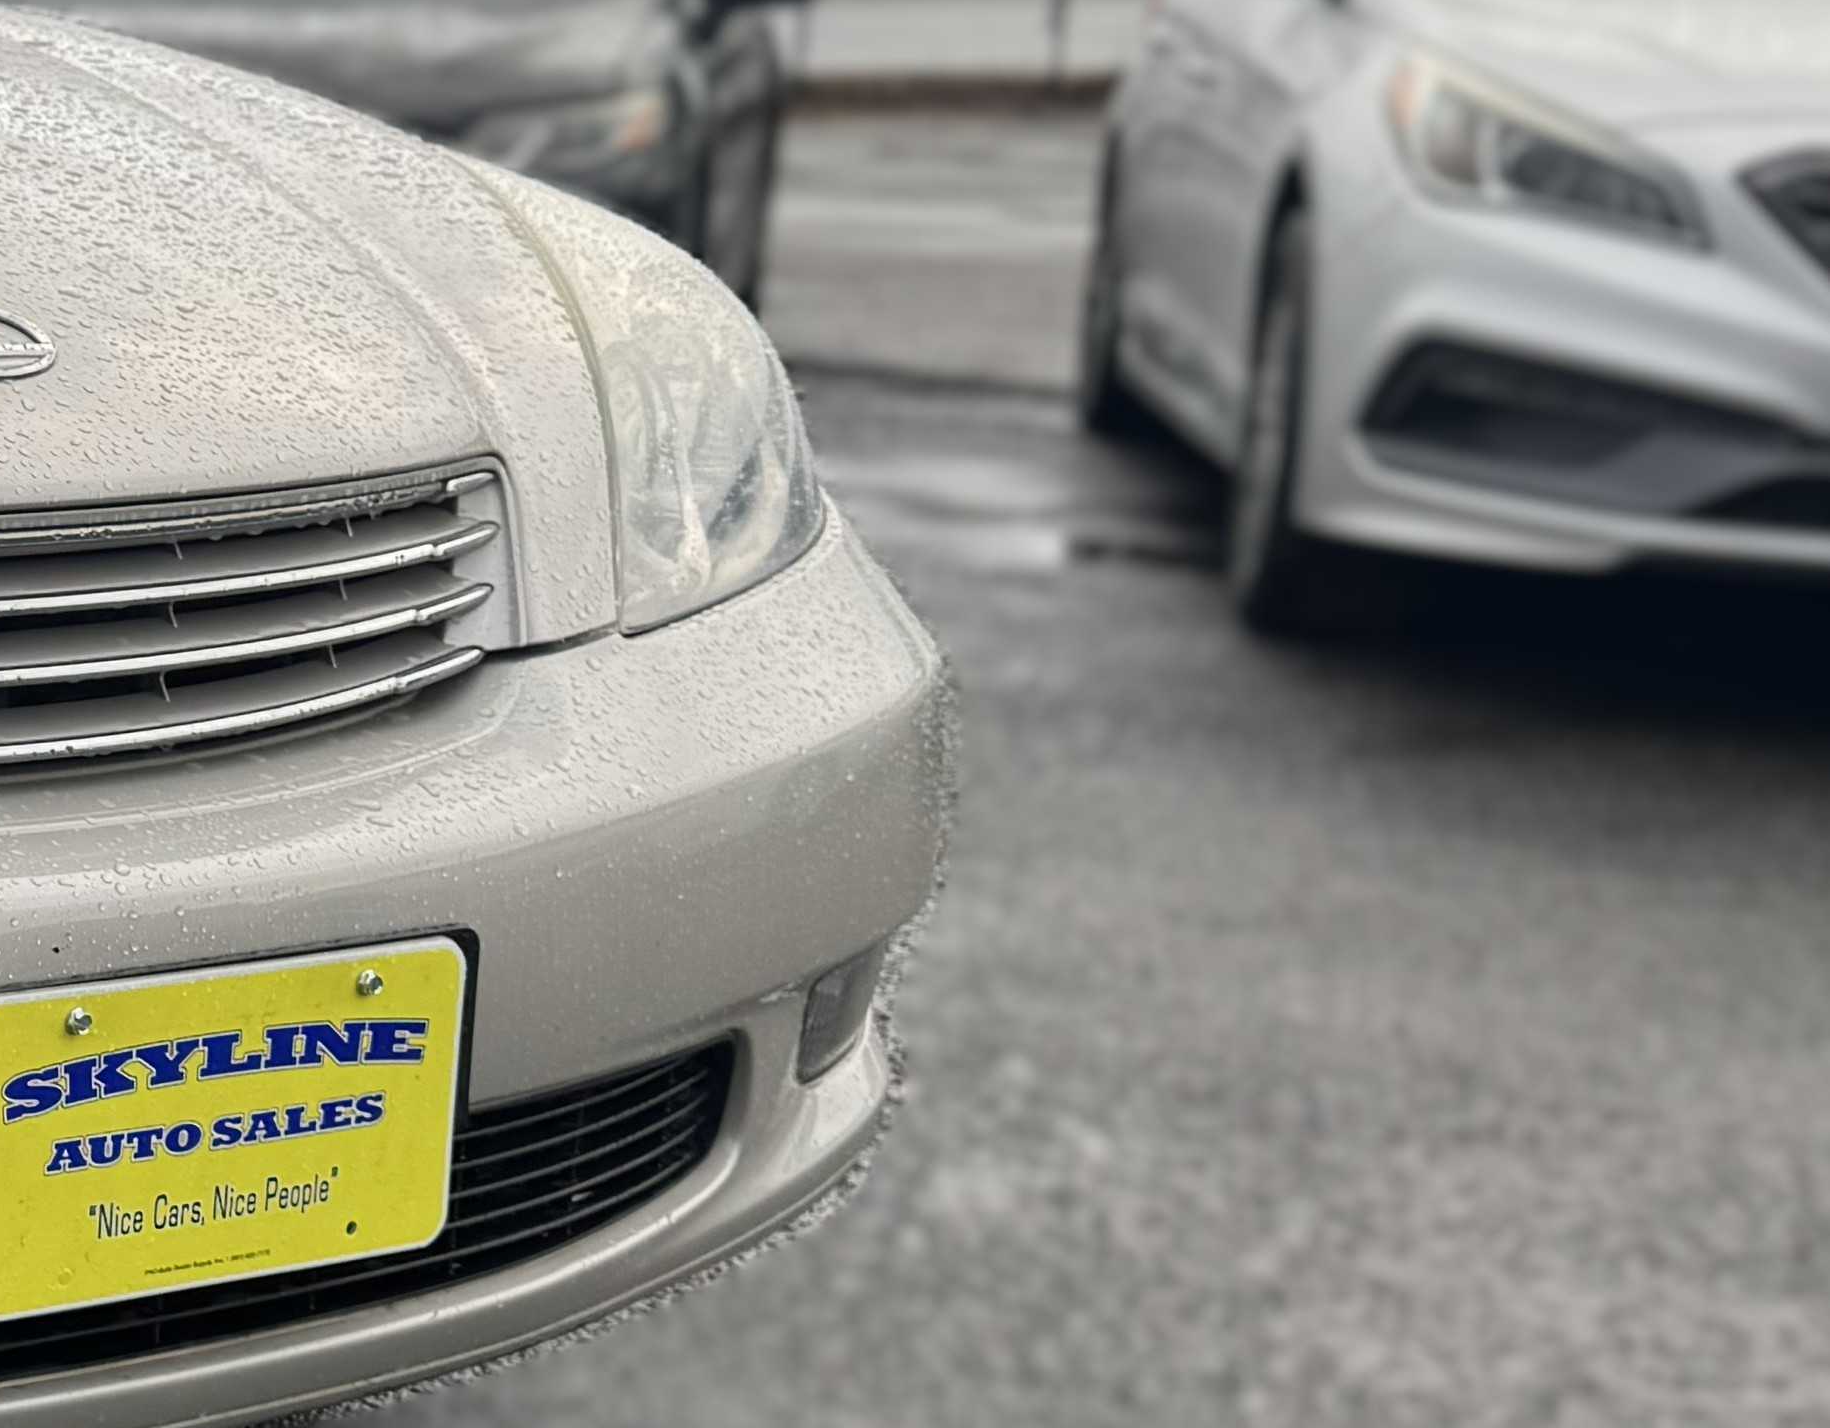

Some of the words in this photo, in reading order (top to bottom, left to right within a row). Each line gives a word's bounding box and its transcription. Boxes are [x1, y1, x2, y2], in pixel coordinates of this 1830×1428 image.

[2, 1019, 430, 1124] SKYLINE
[43, 1123, 202, 1174] AUTO
[210, 1091, 386, 1150] SALES
[152, 1191, 205, 1231] Cars,
[213, 1183, 258, 1220] Nice
